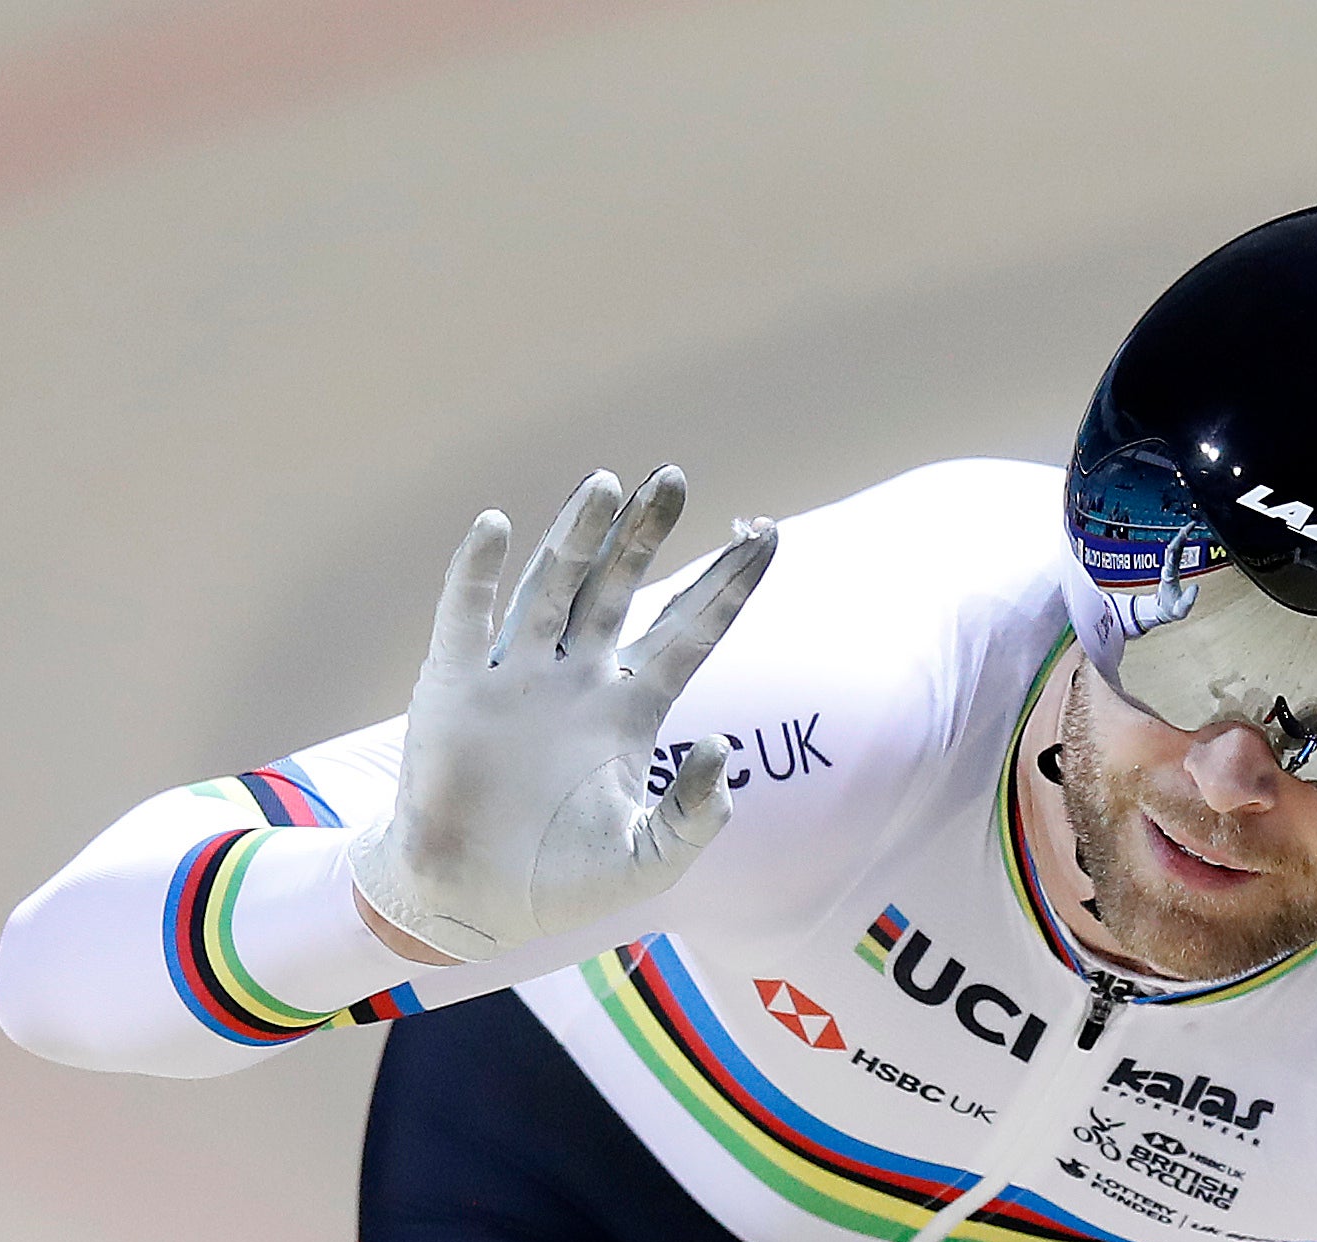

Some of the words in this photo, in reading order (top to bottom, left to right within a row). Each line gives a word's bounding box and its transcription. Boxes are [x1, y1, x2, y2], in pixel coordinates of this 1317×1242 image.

[647, 734, 751, 796] SC
[755, 712, 832, 781] UK
[893, 929, 1047, 1063] UCI
[851, 1048, 946, 1103] HSBC
[950, 1095, 997, 1124] UK
[1106, 1057, 1274, 1131] kalas
[1101, 1085, 1261, 1146] SPORTSWEAR
[1126, 1157, 1233, 1211] CYCLING
[1130, 1144, 1239, 1200] BRITISH
[1189, 1152, 1226, 1172] HSBC
[1090, 1181, 1173, 1224] FUNDED
[1094, 1173, 1177, 1215] LOTTERY
